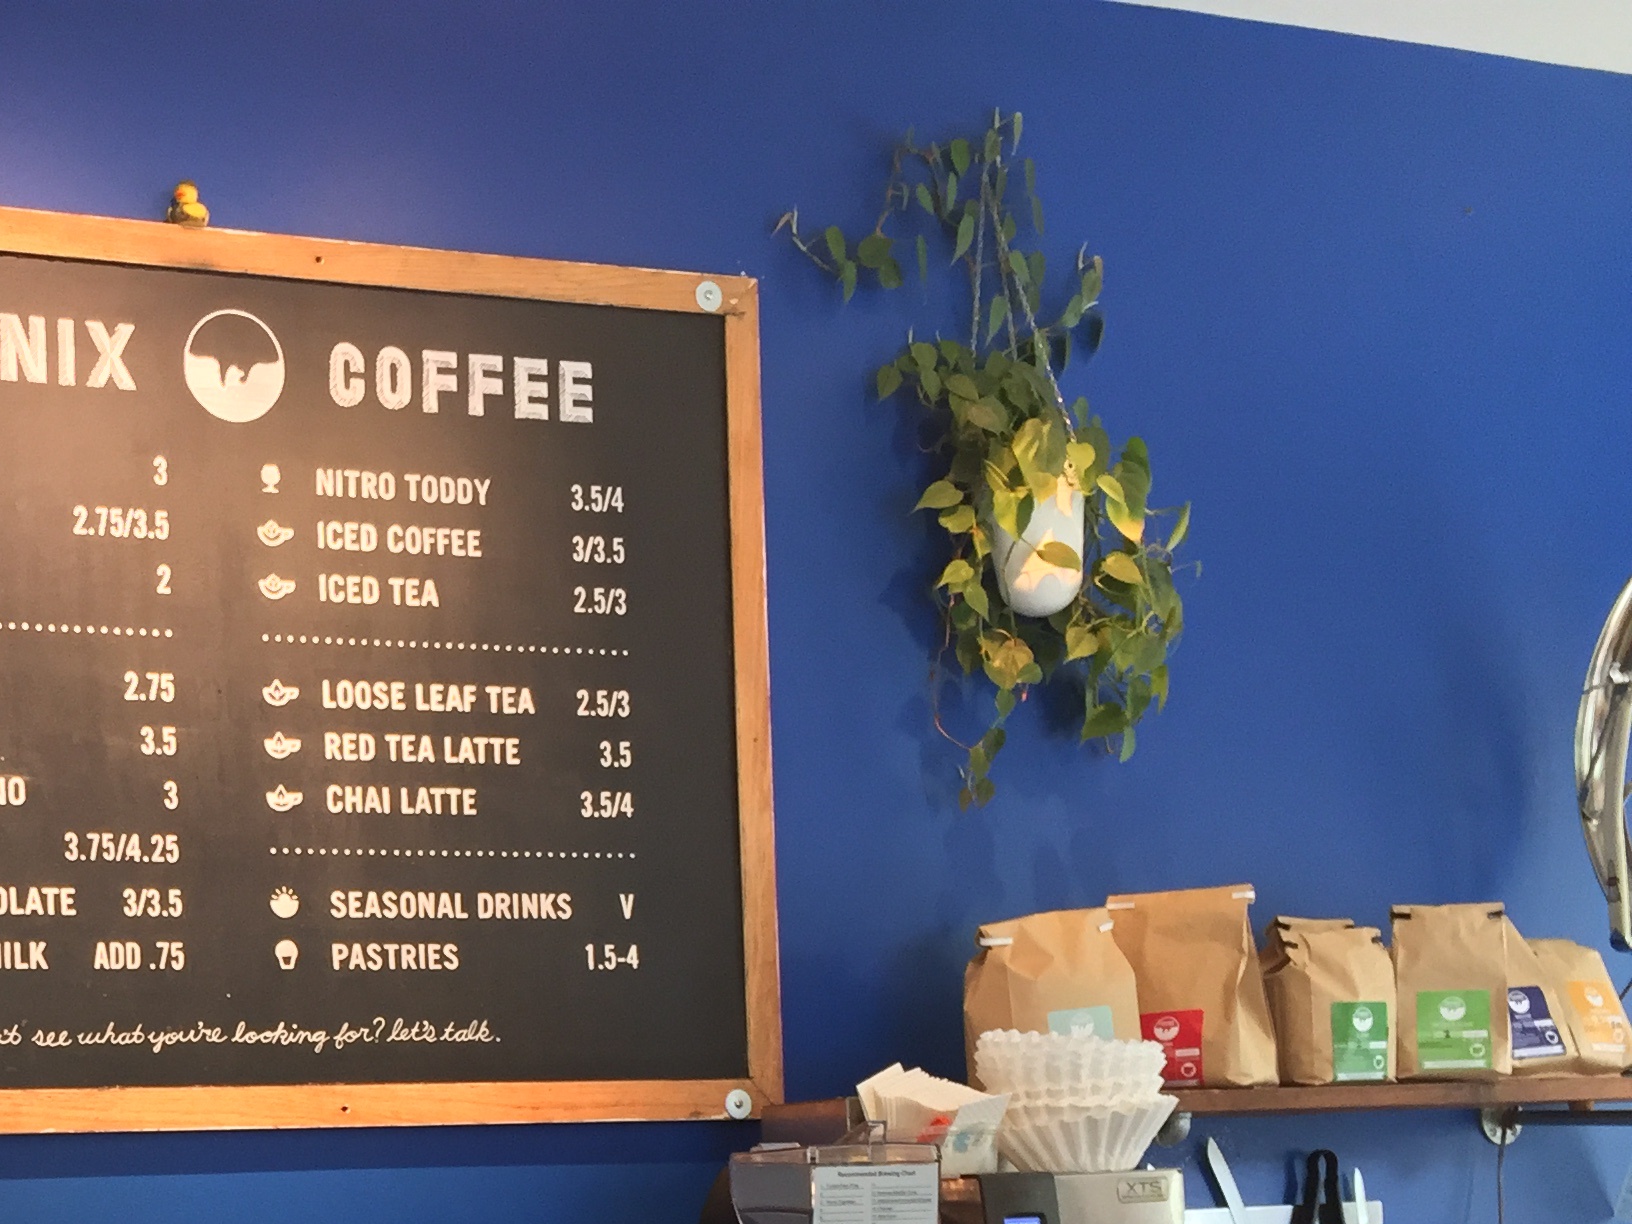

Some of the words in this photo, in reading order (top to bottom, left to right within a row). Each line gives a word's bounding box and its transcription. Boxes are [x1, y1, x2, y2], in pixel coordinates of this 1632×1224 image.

[329, 342, 594, 424] COFFEE
[153, 455, 168, 486] 3
[315, 467, 396, 501] NITRO
[404, 473, 491, 506] TODDY
[571, 484, 625, 514] 3.5/4
[73, 505, 170, 541] 2.75/3.5
[317, 521, 379, 552] ICED
[387, 524, 483, 558] COFFEE
[572, 535, 626, 565] 3/3.5
[157, 564, 172, 595] 2
[319, 573, 381, 605] ICED
[388, 577, 440, 608] TEA
[574, 586, 628, 616] 2.5/3
[124, 671, 175, 703] 2.75
[321, 679, 407, 711] LOOSE
[415, 683, 478, 713] LEAF
[485, 685, 536, 715] TEA
[576, 689, 631, 718] 2.5/3
[140, 726, 177, 756] 3.5
[324, 732, 376, 762] RED
[384, 734, 436, 763] TEA
[444, 736, 521, 766] LATTE
[600, 741, 632, 768] 3.5
[163, 780, 179, 810] 3
[326, 784, 391, 815] CHAI
[401, 787, 478, 816] LATTE
[580, 791, 635, 819] 3.5/4
[64, 831, 180, 864] 3.75/4.25
[123, 888, 184, 918] 3/3.5
[330, 890, 469, 920] SEASONAL
[477, 892, 573, 920] DRINKS
[619, 893, 635, 920] V
[93, 942, 142, 971] ADD
[149, 941, 186, 971] .75
[331, 943, 460, 972] PASTRIES
[585, 944, 640, 971] 1.5-4
[31, 1028, 72, 1047] see
[77, 1021, 145, 1046] what
[147, 1020, 229, 1054] you're
[231, 1020, 331, 1054] looking
[333, 1016, 386, 1050] for?
[386, 1017, 438, 1043] let's
[440, 1019, 502, 1044] talk.
[1126, 1180, 1162, 1194] XTS
